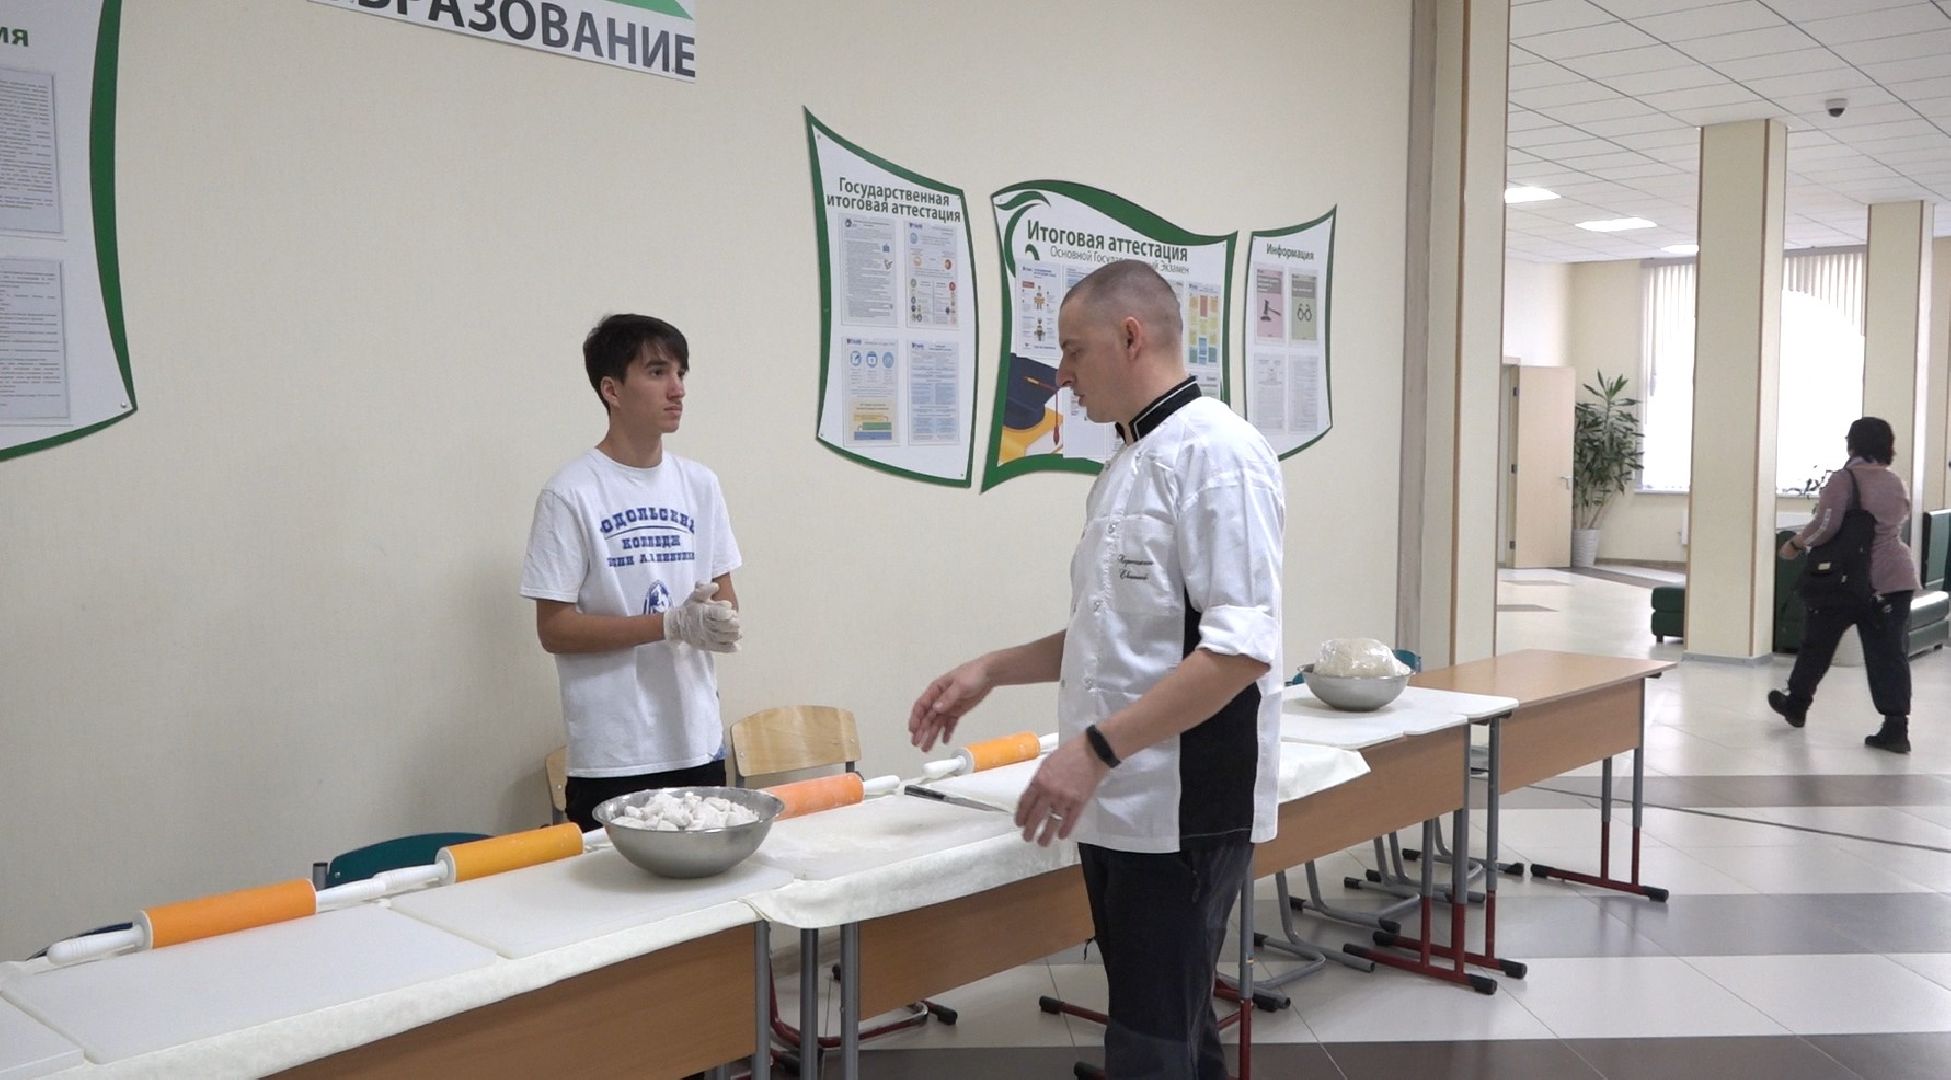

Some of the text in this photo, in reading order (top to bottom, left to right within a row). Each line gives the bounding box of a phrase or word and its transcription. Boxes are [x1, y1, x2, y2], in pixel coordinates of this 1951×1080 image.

[839, 177, 950, 206] Государственная
[826, 194, 961, 223] итоговая аттестация
[1027, 219, 1188, 262] Итоговая аттестация
[1050, 245, 1092, 262] Основной
[1266, 243, 1314, 262] Информация
[600, 507, 695, 534] ОДОЛЬСКИ
